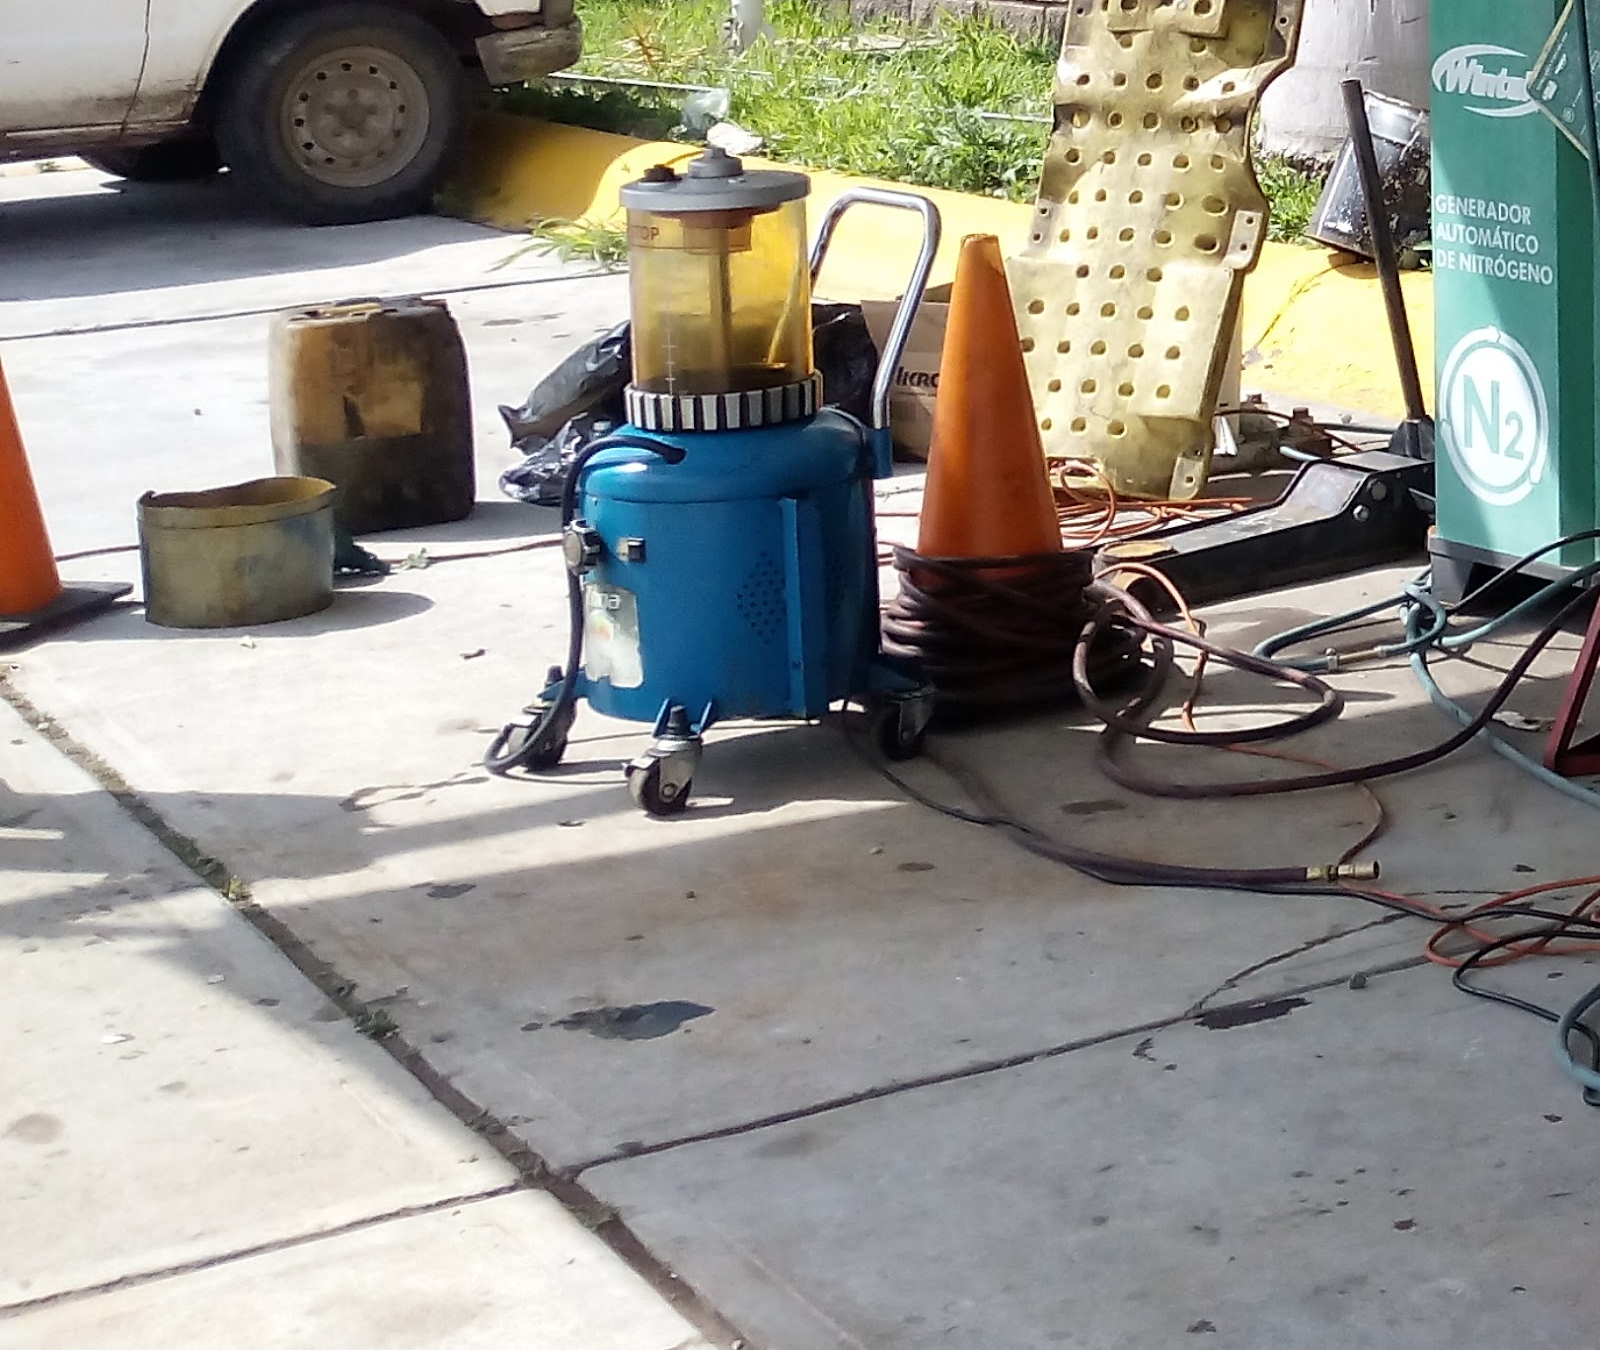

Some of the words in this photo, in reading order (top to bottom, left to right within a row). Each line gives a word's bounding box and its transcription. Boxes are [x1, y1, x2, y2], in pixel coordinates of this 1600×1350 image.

[1435, 193, 1531, 226] GENERADOR
[1435, 221, 1539, 255] AUTOMÁTICO
[1436, 249, 1456, 270] DE
[1459, 253, 1553, 286] NITRÓGENO
[1463, 373, 1525, 461] N2
